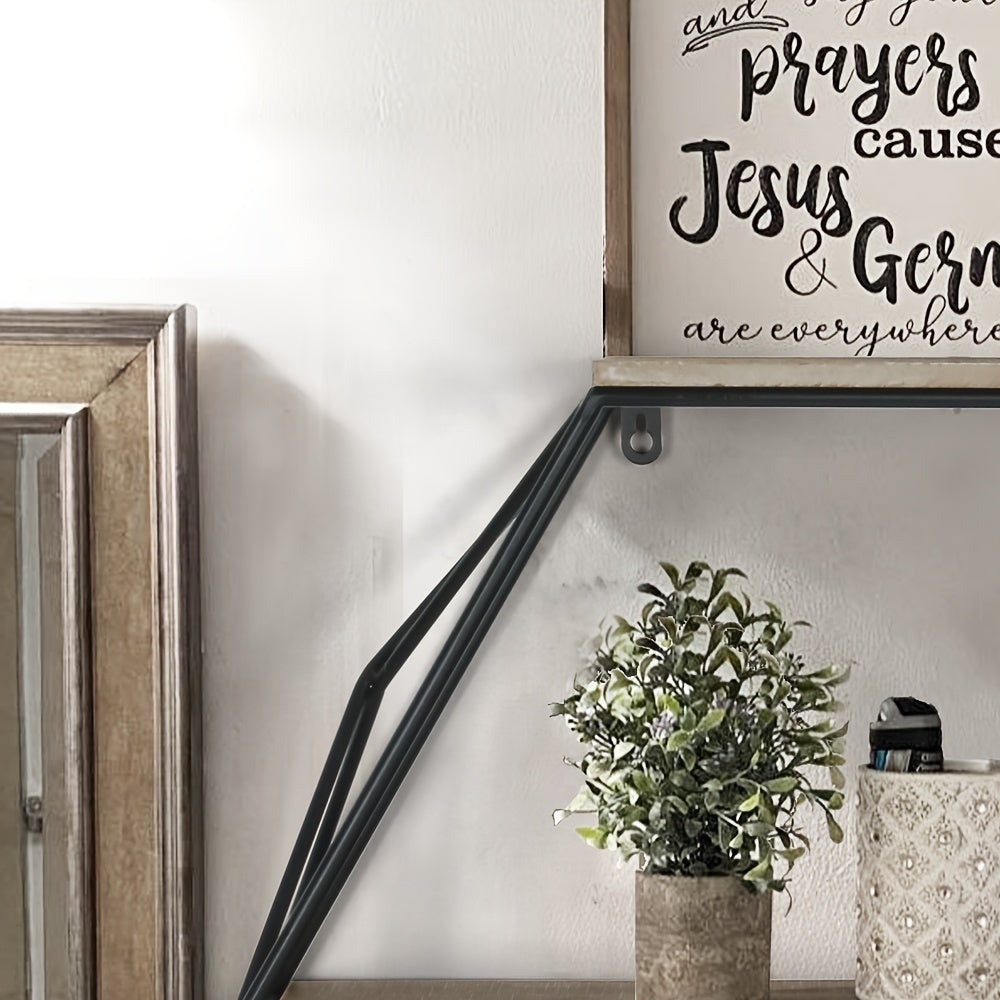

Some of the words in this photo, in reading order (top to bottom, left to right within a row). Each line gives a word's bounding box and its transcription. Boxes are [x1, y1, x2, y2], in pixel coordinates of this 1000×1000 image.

[741, 32, 980, 125] prayers
[669, 139, 853, 244] Jesus
[785, 227, 838, 297] &
[683, 318, 763, 344] are
